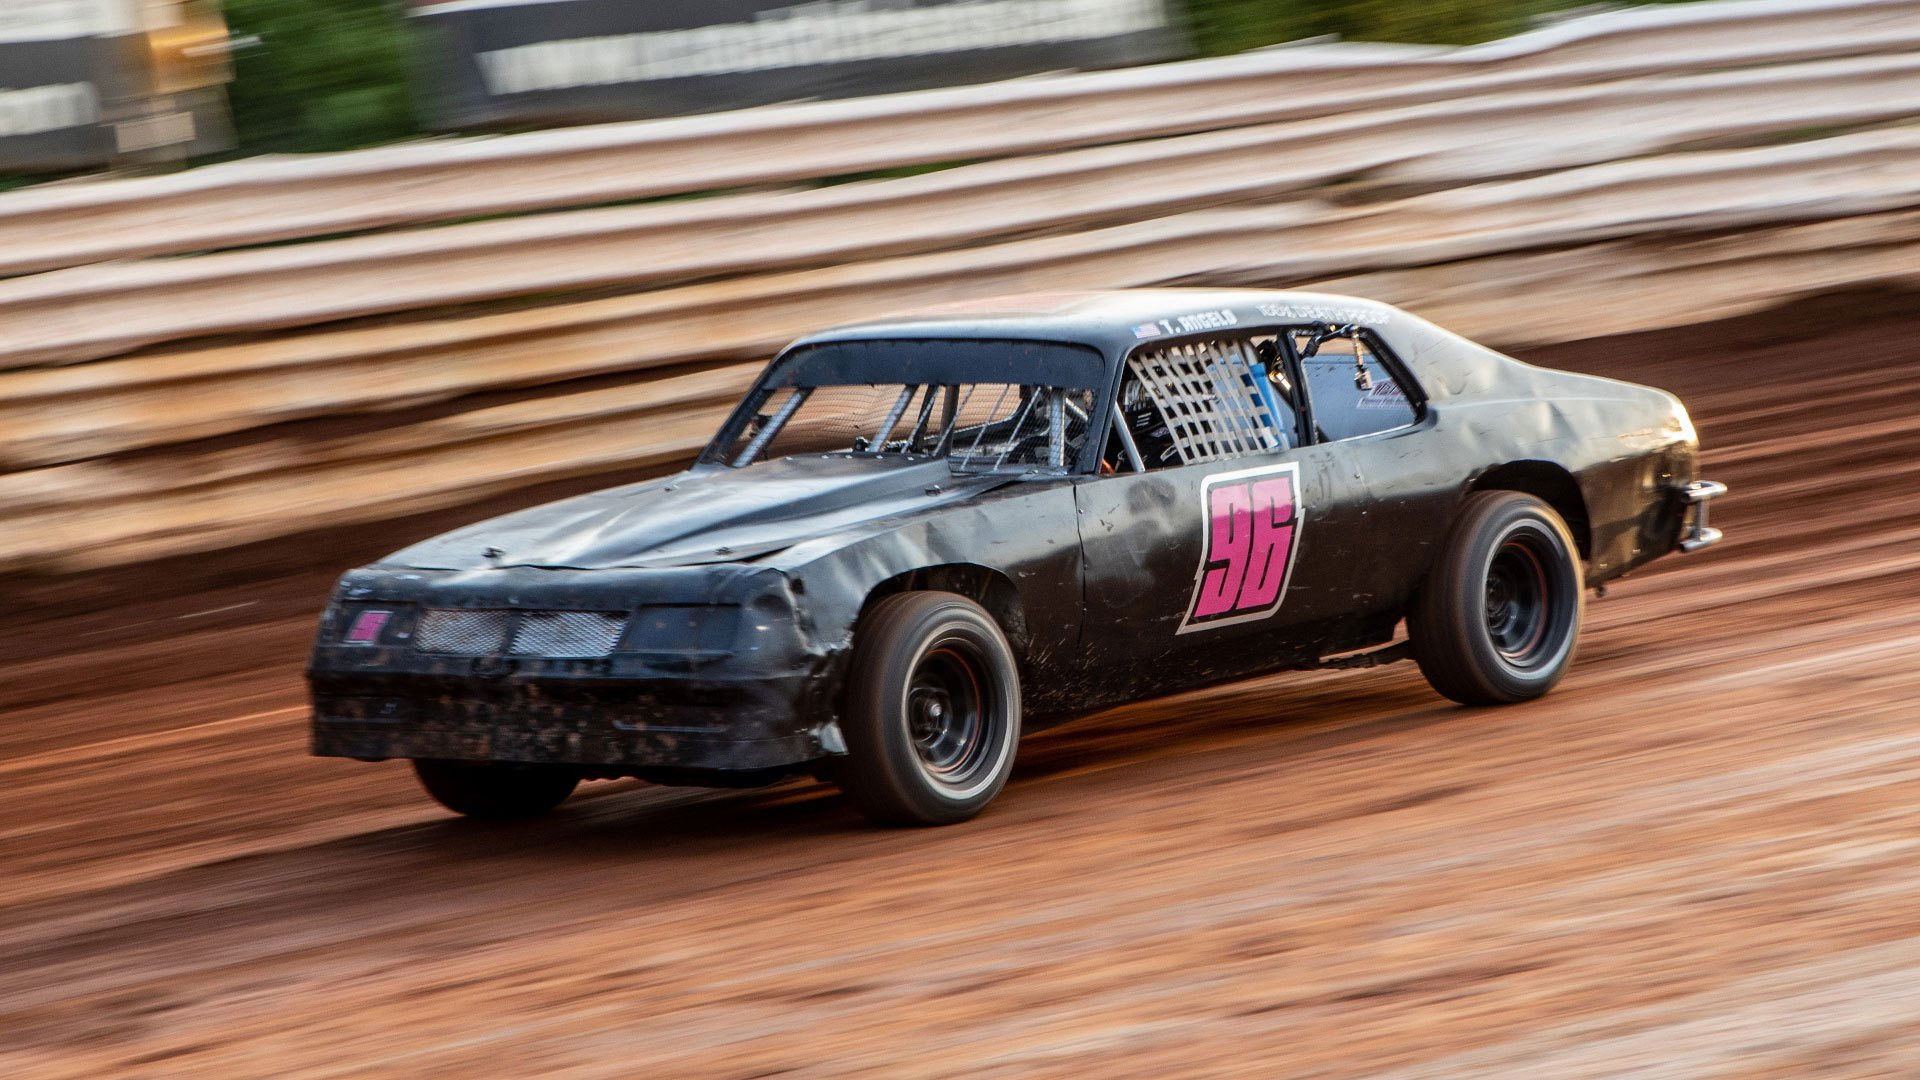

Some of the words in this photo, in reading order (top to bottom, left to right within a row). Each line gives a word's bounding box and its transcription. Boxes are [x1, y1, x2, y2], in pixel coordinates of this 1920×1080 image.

[1159, 319, 1181, 334] T.
[1177, 309, 1237, 332] ANGELO
[1194, 477, 1293, 617] 96
